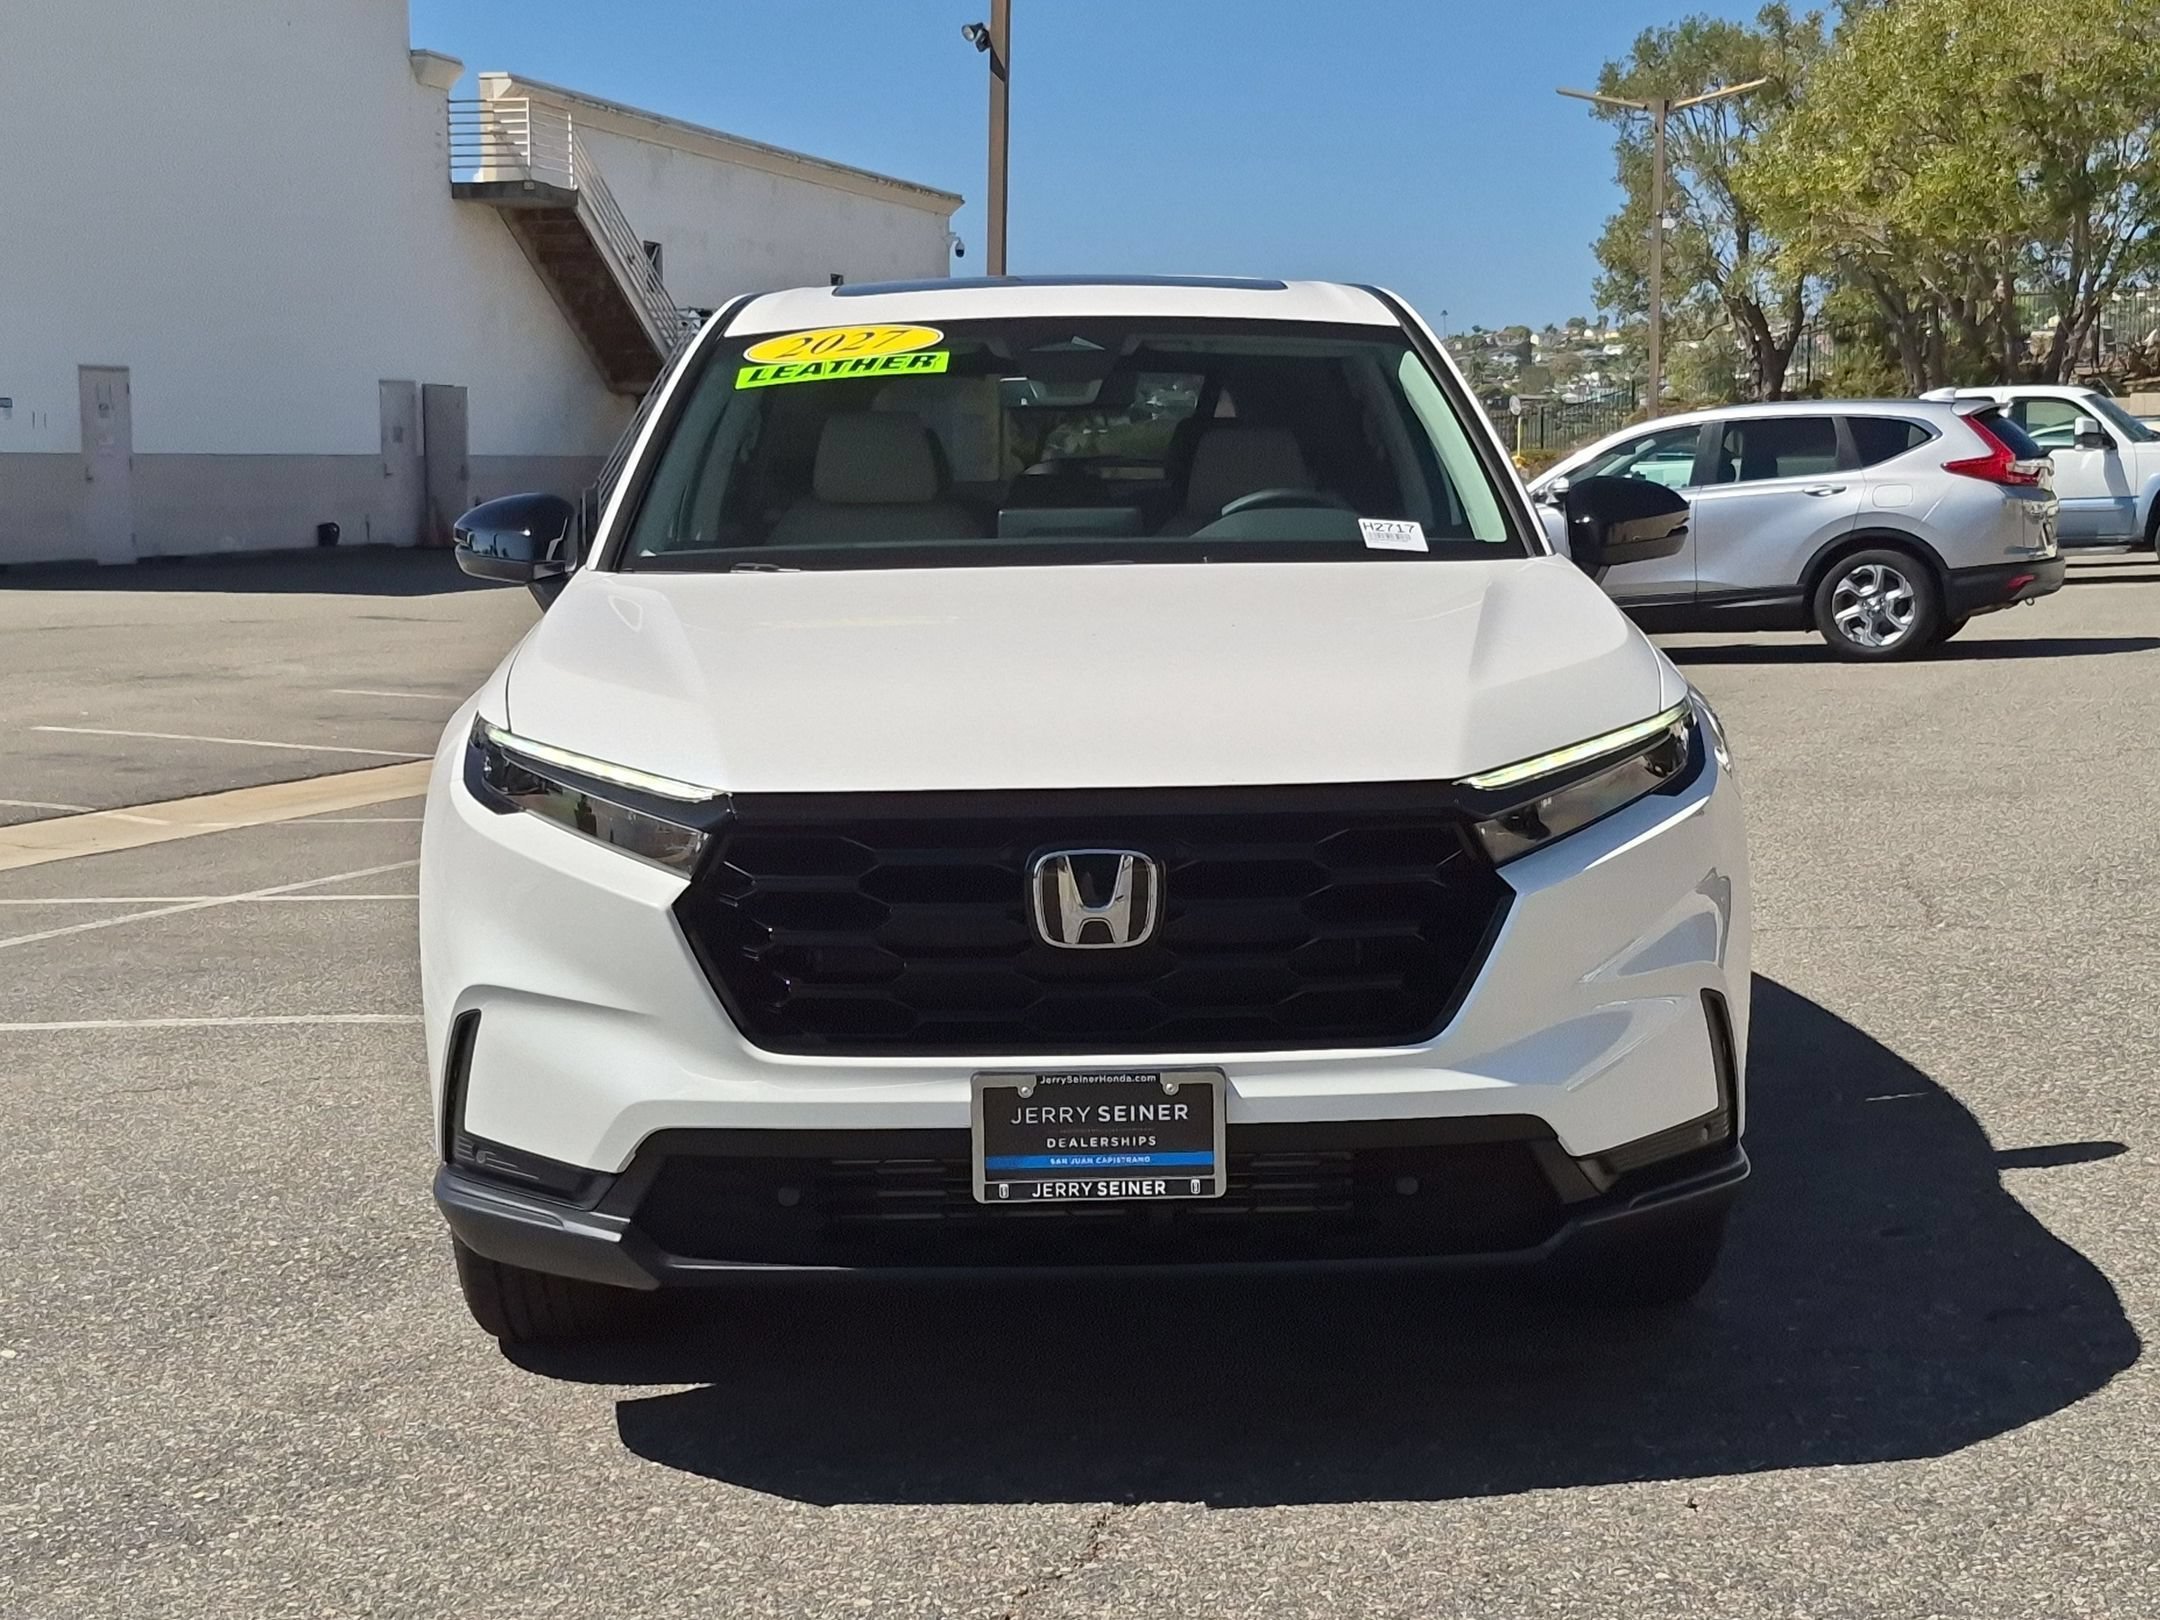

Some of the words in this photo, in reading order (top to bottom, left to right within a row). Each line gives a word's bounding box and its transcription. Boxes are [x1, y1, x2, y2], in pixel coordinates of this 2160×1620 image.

[775, 329, 913, 359] 2027
[747, 354, 940, 383] LEATHER
[1362, 521, 1415, 533] H2717
[1039, 1073, 1157, 1085] JerrySeinerHonda.com
[1010, 1106, 1091, 1125] JERRY
[1097, 1104, 1189, 1122] SEINER
[1046, 1135, 1157, 1149] DEALERSHIPS
[1050, 1157, 1068, 1165] SAN
[1070, 1157, 1094, 1165] JUAN
[1095, 1155, 1151, 1164] CAPISTRANO
[1031, 1182, 1093, 1198] JERRY
[1097, 1180, 1167, 1196] SEINER
